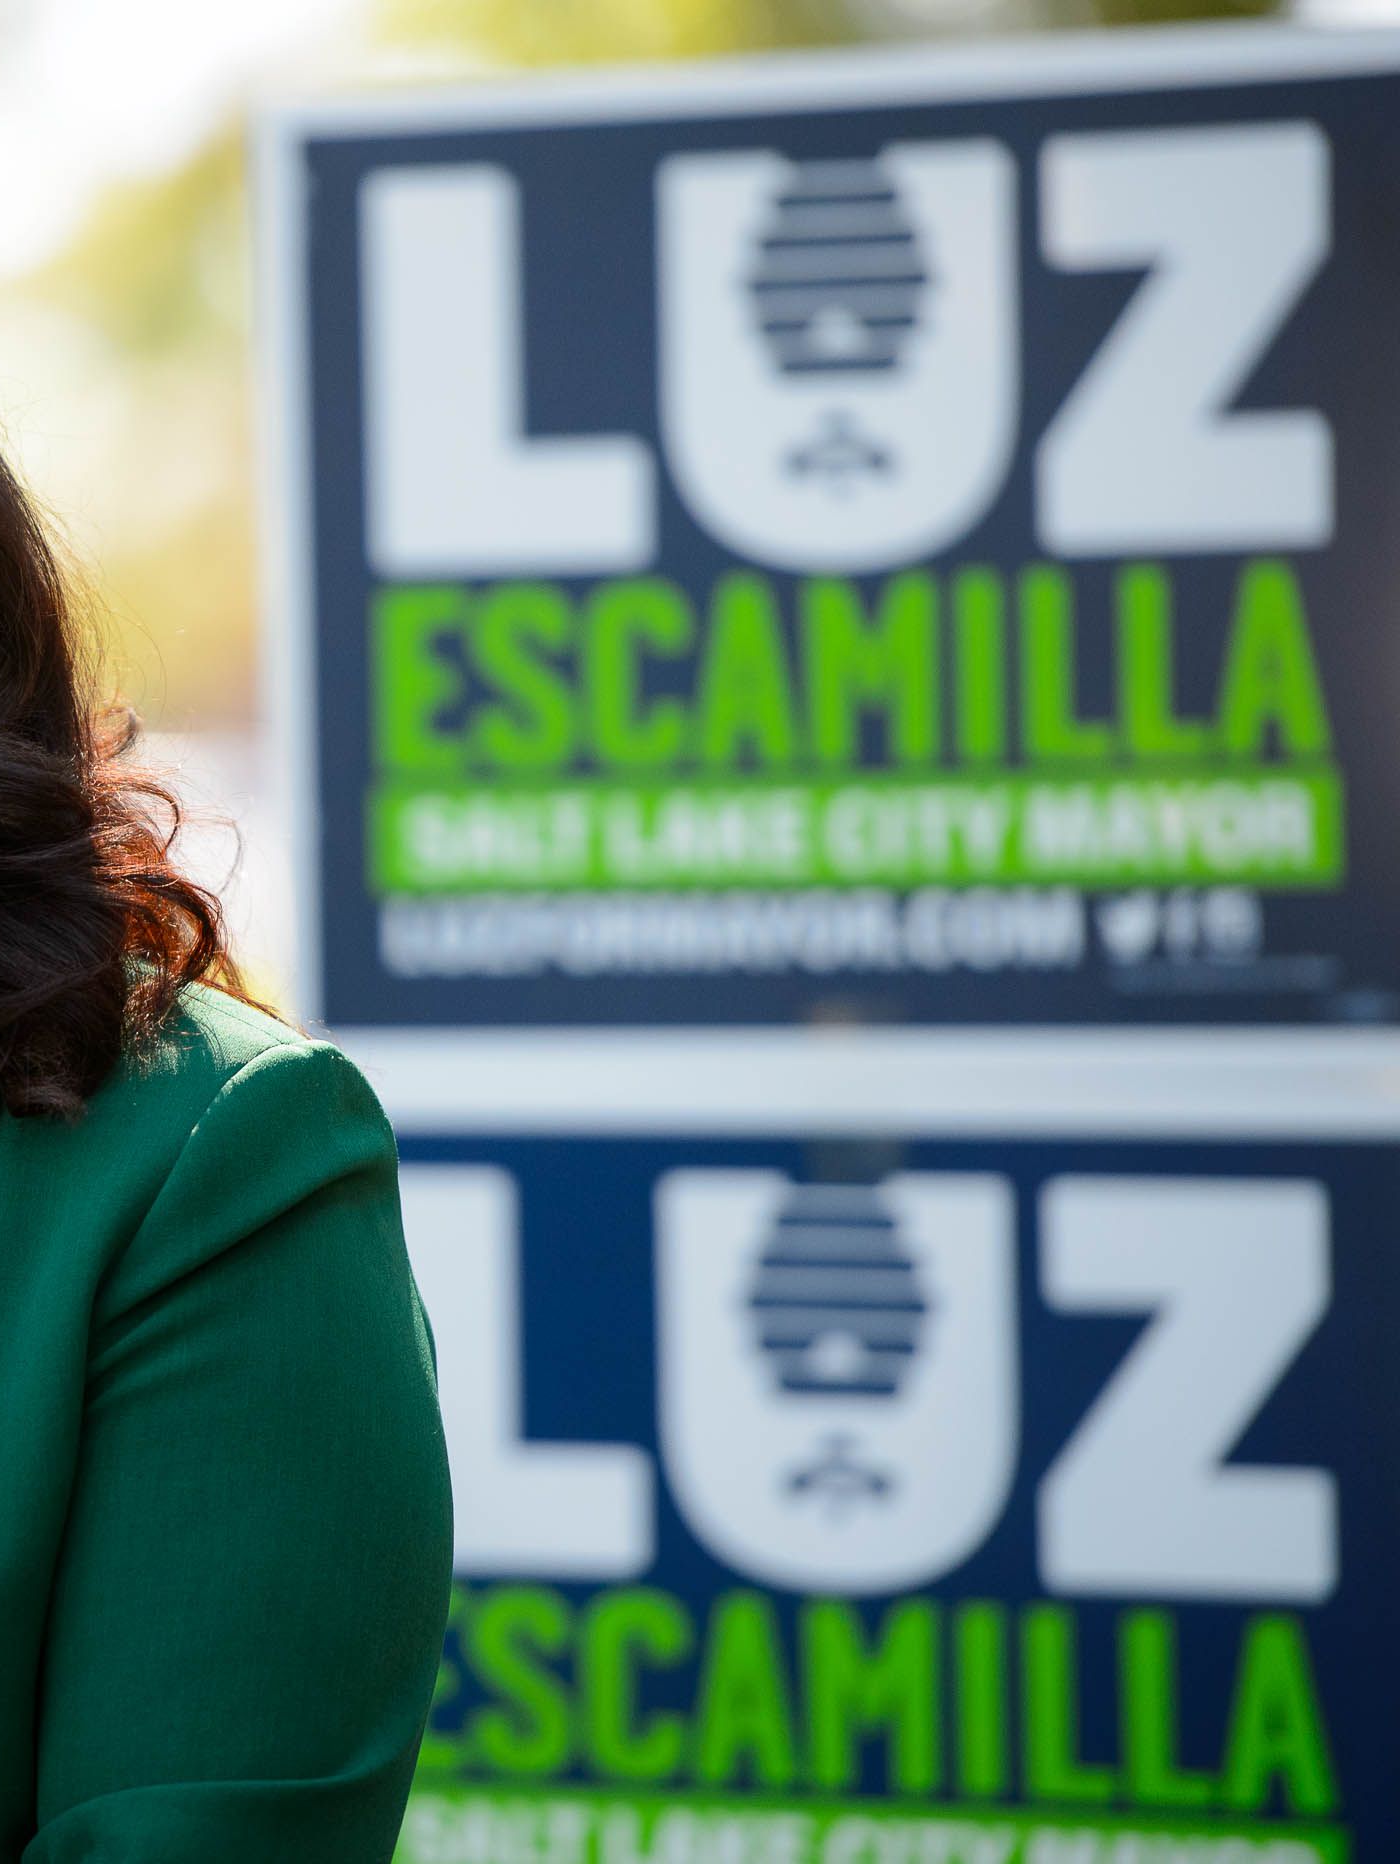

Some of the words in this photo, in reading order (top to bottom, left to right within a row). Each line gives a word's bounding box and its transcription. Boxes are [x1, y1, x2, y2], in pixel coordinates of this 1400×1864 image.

[359, 119, 1335, 578] LUZ
[371, 560, 1333, 774] ESCAMILLA
[400, 789, 591, 885] SALT
[599, 788, 812, 884] LAKE
[819, 784, 1012, 880] CITY
[1021, 778, 1318, 876] MAYOR
[397, 1162, 1340, 1603] LUZ
